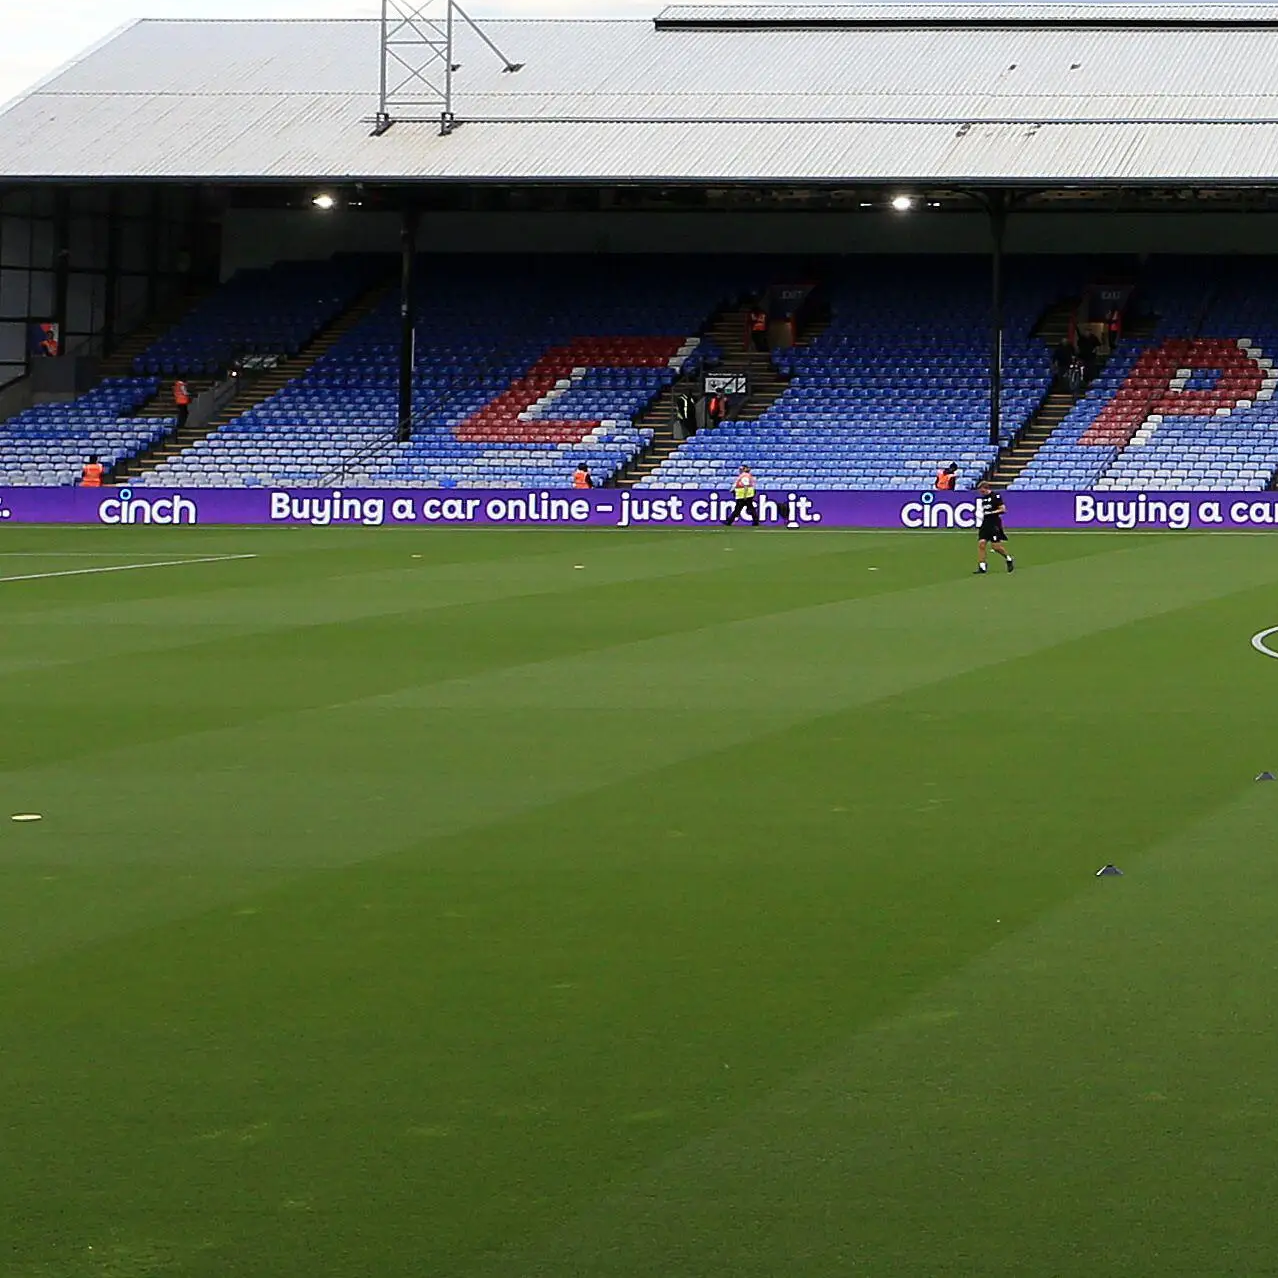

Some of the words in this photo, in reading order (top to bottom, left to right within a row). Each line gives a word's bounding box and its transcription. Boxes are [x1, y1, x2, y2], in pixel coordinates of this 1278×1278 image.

[99, 488, 197, 524] cinch
[271, 491, 385, 525] Buying
[393, 499, 417, 520] a
[424, 499, 482, 520] car
[487, 491, 591, 521] online
[616, 491, 684, 526] just
[788, 493, 822, 522] it.
[1075, 493, 1191, 529] Buying
[1198, 502, 1223, 523] a
